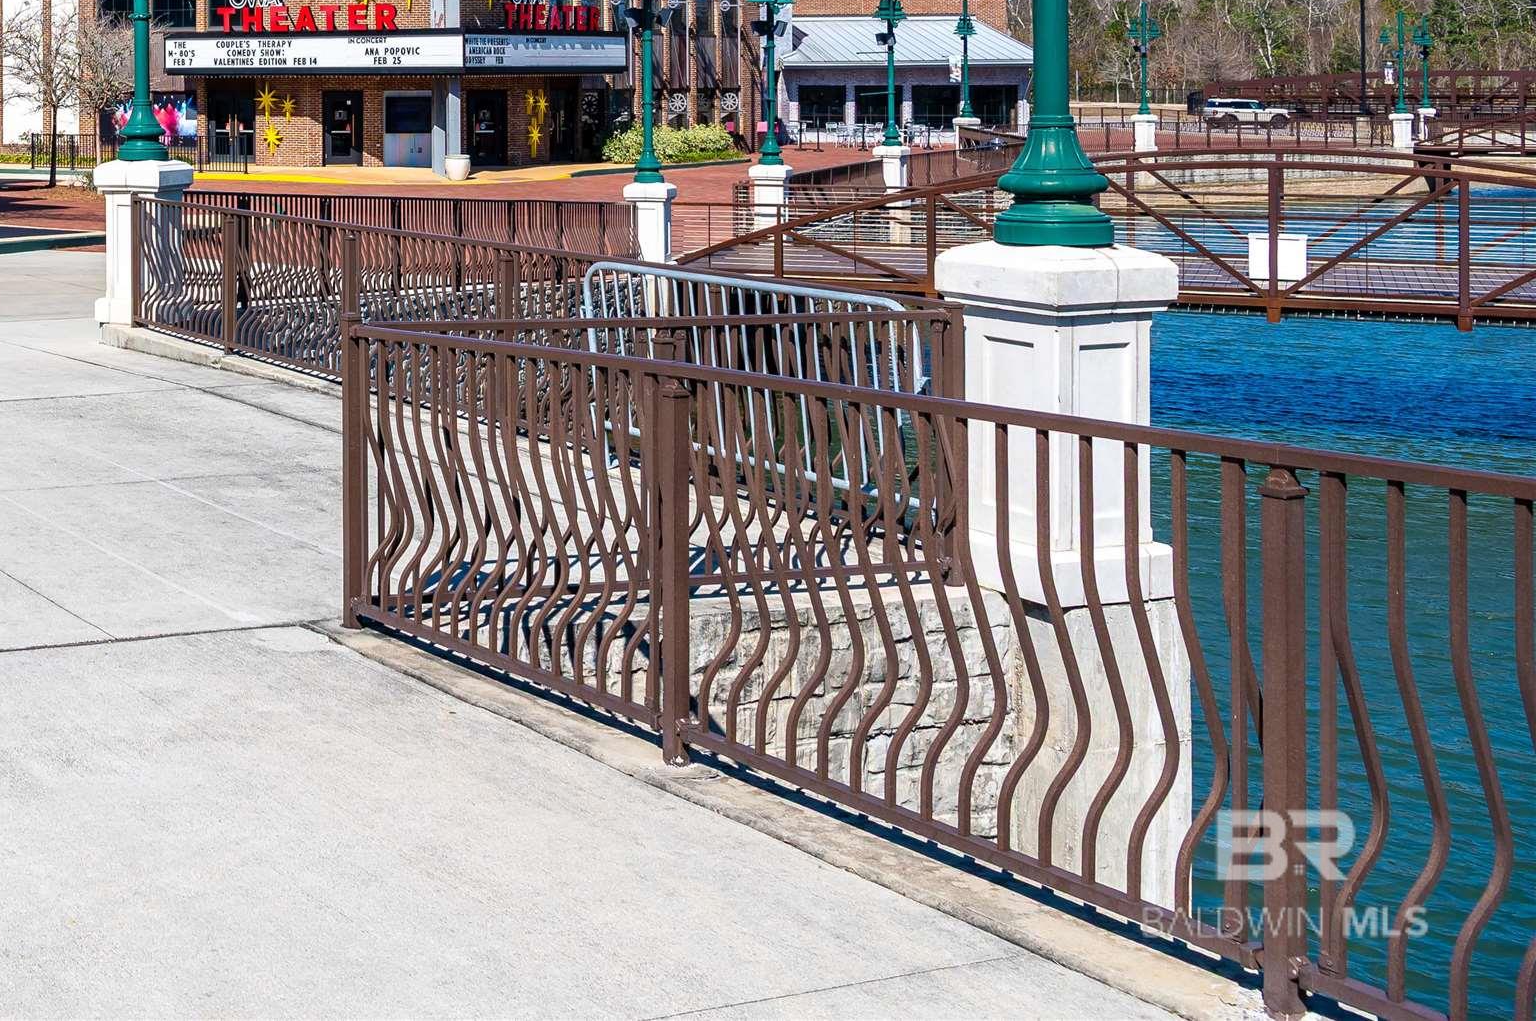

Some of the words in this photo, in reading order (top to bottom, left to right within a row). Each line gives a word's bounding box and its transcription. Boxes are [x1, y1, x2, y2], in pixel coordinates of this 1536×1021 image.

[216, 3, 397, 33] THEATER
[504, 2, 601, 31] THEATER
[356, 36, 387, 44] CONCERT
[173, 41, 187, 49] THE
[215, 41, 251, 49] COUPLE'S
[258, 40, 293, 48] THERAPY
[226, 49, 257, 57] COMEDY
[260, 49, 285, 57] SHOW:
[364, 47, 379, 56] ANA
[384, 46, 421, 56] POPOVIC
[468, 47, 492, 55] AMERICAN
[493, 47, 506, 55] ROCK
[173, 58, 186, 66] FEB
[189, 58, 193, 66] 7
[214, 58, 254, 66] VALENTINES
[258, 57, 287, 66] EDITION
[293, 57, 307, 66] FEB
[309, 57, 318, 66] 14
[373, 56, 387, 65] FEB
[392, 56, 402, 65] 25
[495, 56, 504, 64] FEB
